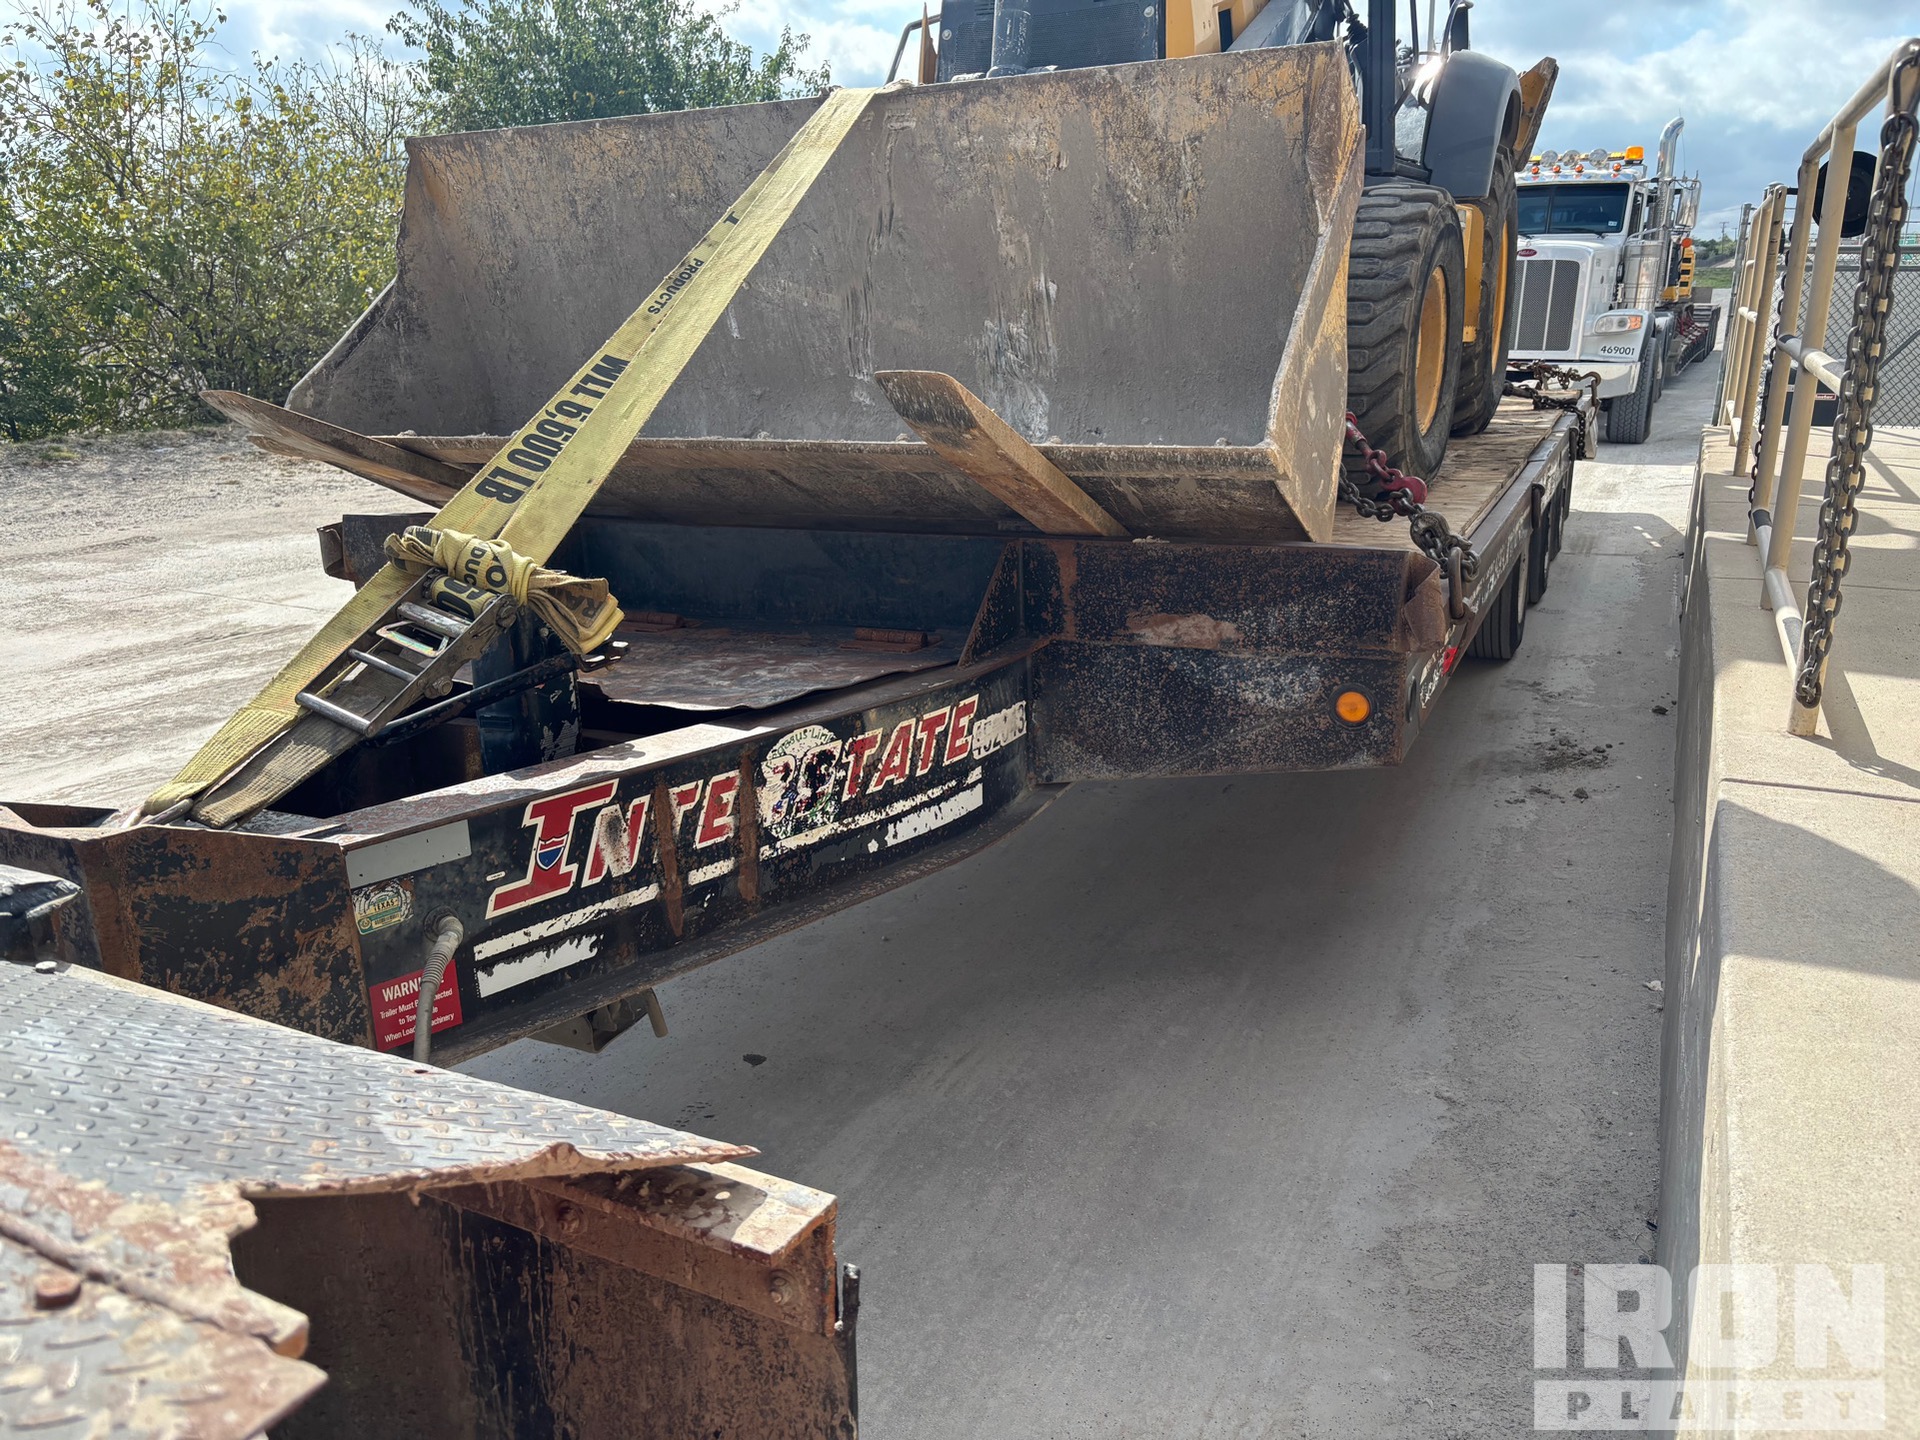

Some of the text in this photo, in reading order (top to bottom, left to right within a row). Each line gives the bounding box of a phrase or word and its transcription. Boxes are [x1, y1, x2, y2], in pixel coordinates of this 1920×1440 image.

[647, 258, 705, 315] PRODUCTS
[1600, 345, 1635, 356] 469001
[569, 354, 631, 400] WLL
[475, 466, 536, 504] LB
[382, 976, 444, 1002] WARNI
[380, 1007, 398, 1019] Trailer
[398, 1001, 414, 1013] Must
[384, 1031, 402, 1042] When
[431, 1013, 454, 1026] achinery
